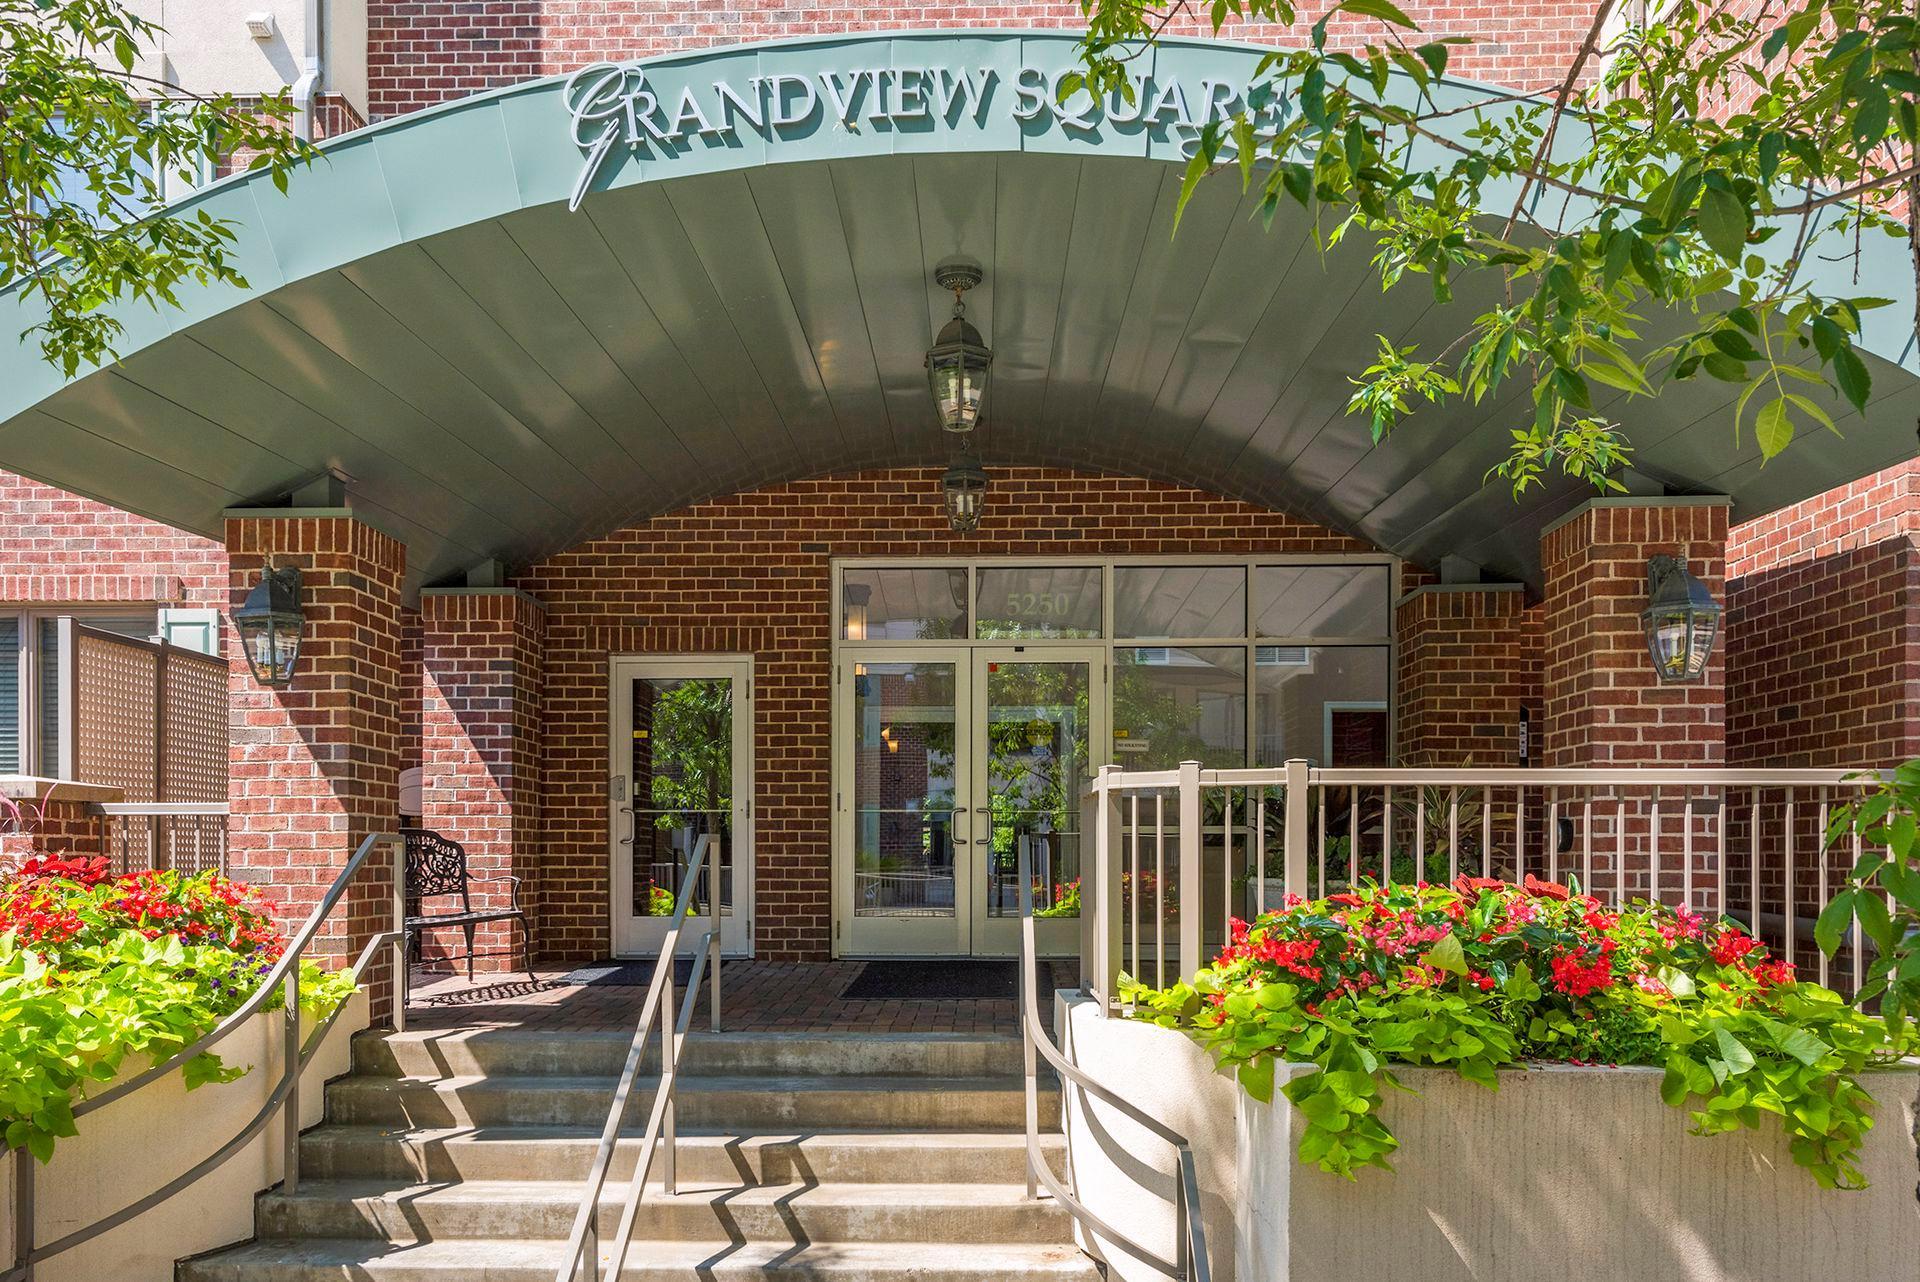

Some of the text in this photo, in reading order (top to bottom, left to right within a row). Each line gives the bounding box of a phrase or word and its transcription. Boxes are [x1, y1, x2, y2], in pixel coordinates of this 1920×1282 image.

[563, 63, 1288, 212] GRANDVIEW SQUARE
[1007, 592, 1069, 616] 5250
